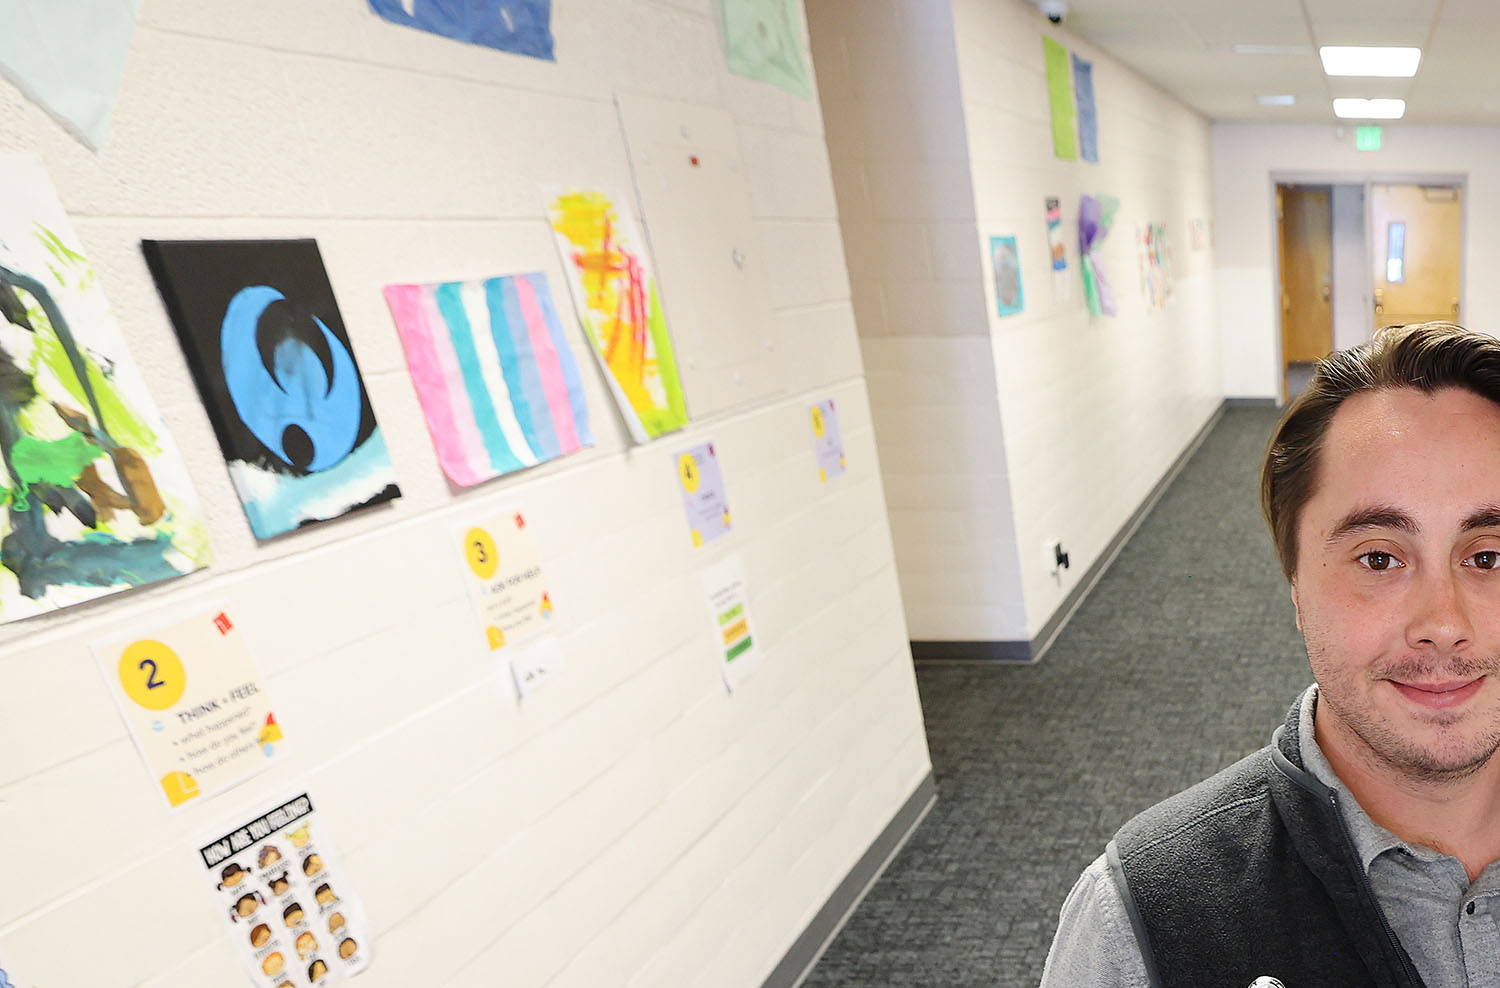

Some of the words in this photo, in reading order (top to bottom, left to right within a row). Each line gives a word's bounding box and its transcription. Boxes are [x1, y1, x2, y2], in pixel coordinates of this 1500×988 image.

[473, 540, 488, 564] 3
[139, 659, 165, 690] 2
[177, 699, 221, 724] THINK
[229, 681, 261, 703] FEEL
[203, 837, 232, 866] HOW
[230, 827, 254, 853] ARE
[246, 818, 272, 841] YOU
[266, 796, 310, 831] FEELING?
